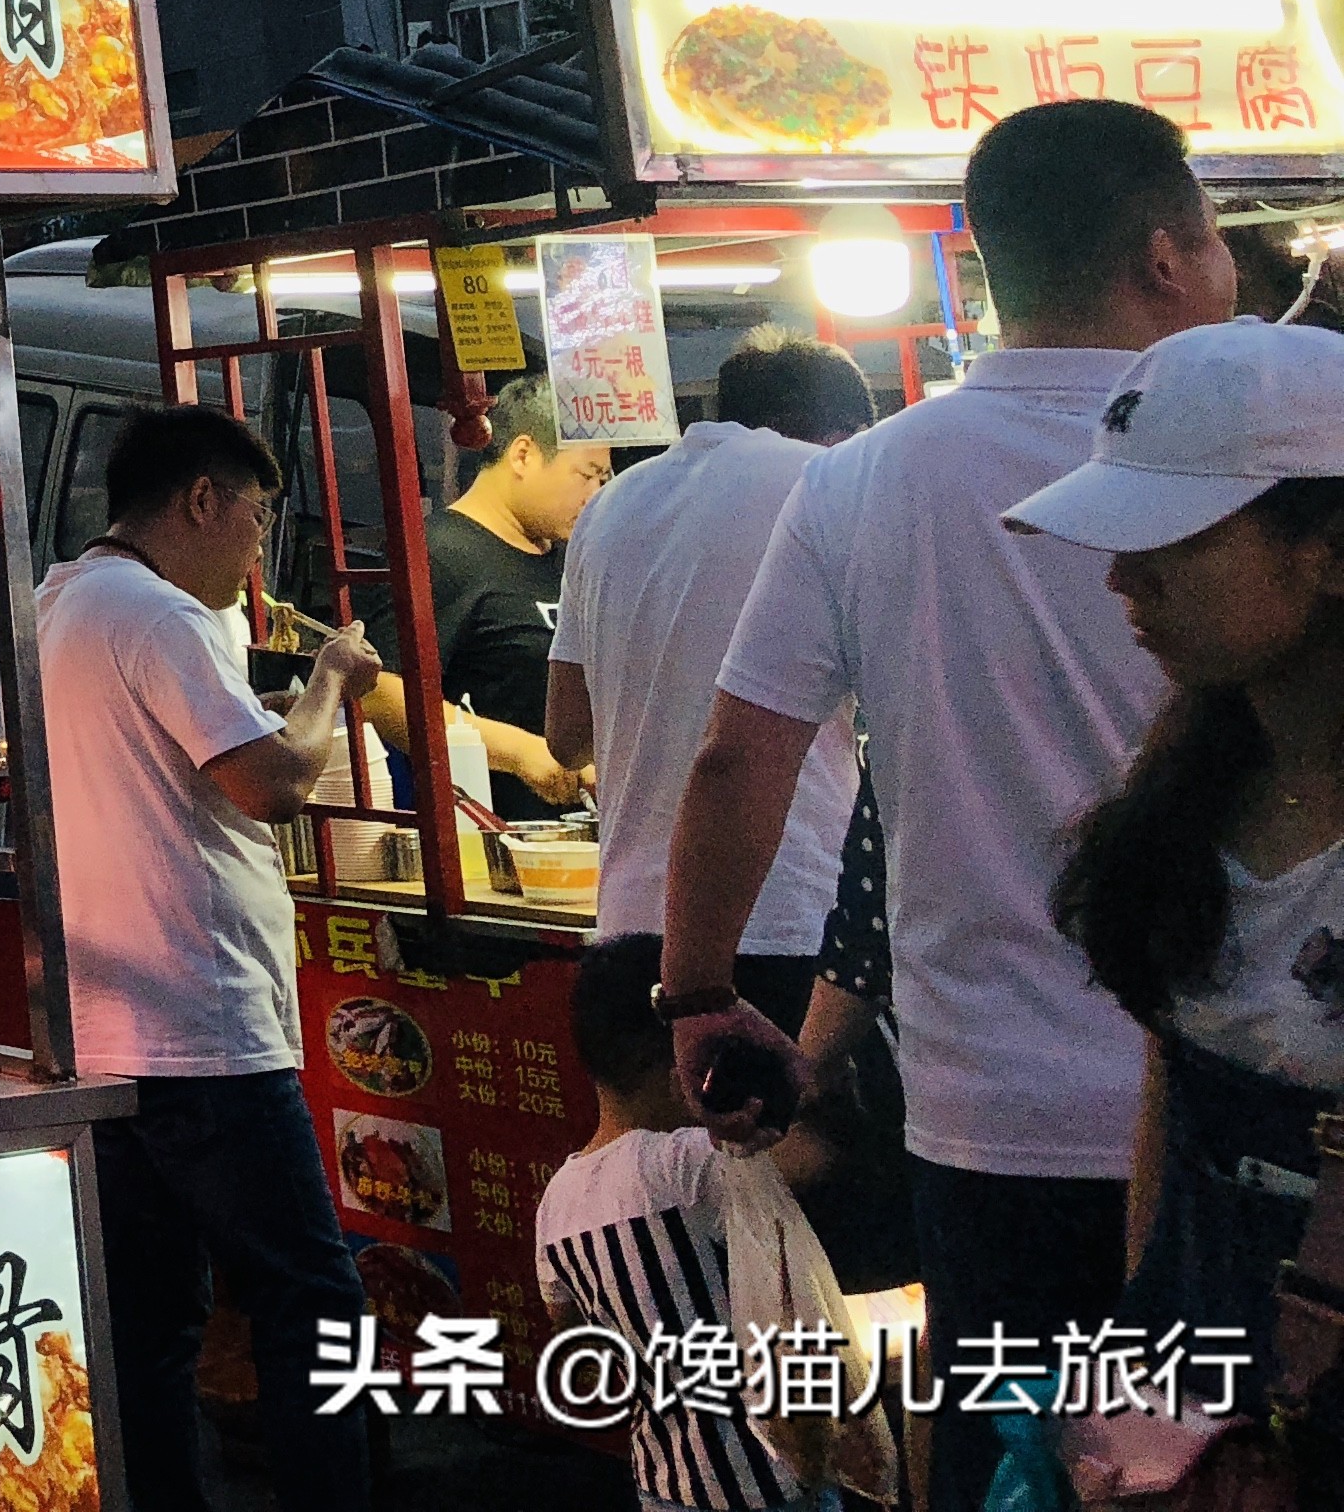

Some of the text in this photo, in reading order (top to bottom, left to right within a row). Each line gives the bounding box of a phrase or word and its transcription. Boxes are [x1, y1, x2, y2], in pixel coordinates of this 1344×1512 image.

[913, 33, 1318, 132] 铁板豆腐
[463, 275, 488, 294] 80
[571, 346, 646, 379] 4元一根
[571, 390, 658, 424] 10元三根
